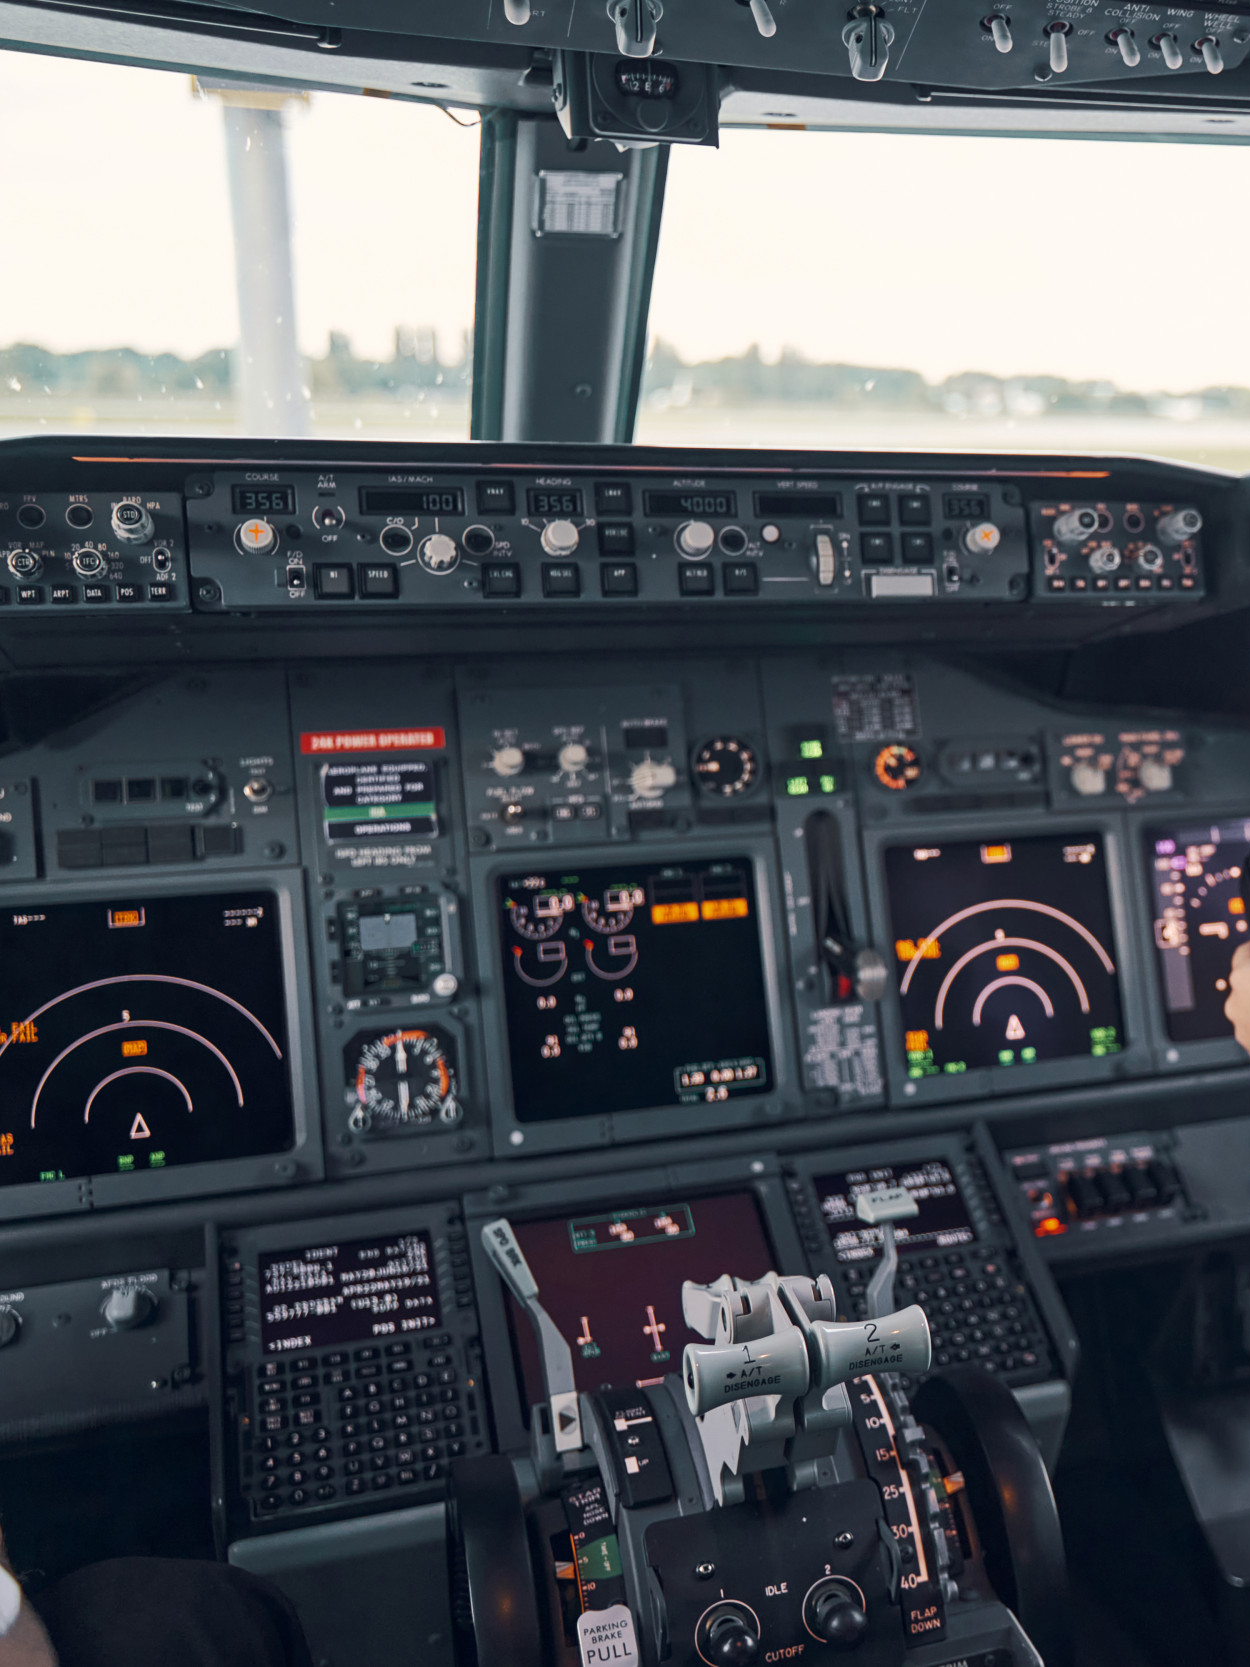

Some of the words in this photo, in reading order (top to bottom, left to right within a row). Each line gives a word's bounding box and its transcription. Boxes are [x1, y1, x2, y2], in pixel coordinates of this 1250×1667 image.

[1046, 2, 1082, 13] STROBE
[1123, 3, 1150, 12] ANTI
[1167, 8, 1194, 18] WING
[1048, 10, 1087, 19] STEADY
[1105, 8, 1161, 21] COLLISION
[1204, 12, 1240, 23] WHEEL
[1204, 20, 1233, 29] WELL
[245, 473, 279, 481] COURSE
[318, 474, 334, 482] A/T
[536, 478, 571, 486] HEADING
[317, 481, 336, 489] ARM
[69, 494, 88, 503] MTRS
[246, 493, 284, 509] 356
[423, 495, 453, 510] 100
[538, 496, 572, 512] 356
[146, 502, 161, 510] HPA
[681, 497, 726, 512] 4000
[122, 510, 137, 519] STD
[322, 535, 338, 543] OFF
[84, 541, 94, 549] 40
[98, 543, 107, 551] 80
[140, 556, 151, 564] OFF
[156, 573, 169, 581] ADF
[171, 573, 176, 581] 2
[20, 590, 36, 598] WPT
[53, 589, 70, 598] ARPT
[86, 589, 102, 597] DATA
[120, 588, 134, 596] POS
[151, 587, 166, 595] TERR
[336, 734, 377, 747] POWER
[378, 732, 434, 746] OPERATED
[354, 822, 411, 835] OPERATIONS
[372, 1321, 395, 1335] POS
[864, 1323, 880, 1342] 2
[743, 1345, 756, 1364] 1
[865, 1345, 886, 1356] A/T
[849, 1354, 903, 1370] DISENGAGE
[741, 1366, 763, 1379] A/T
[724, 1375, 781, 1393] DISENGAGE
[860, 1393, 871, 1404] 5
[865, 1416, 880, 1430] 10
[876, 1448, 890, 1461] 15
[883, 1484, 899, 1499] 25
[583, 1507, 604, 1518] NOSE
[583, 1512, 609, 1526] DOWN
[891, 1524, 908, 1540] 30
[824, 1564, 832, 1575] 2
[588, 1582, 596, 1591] 10
[901, 1573, 918, 1590] 40
[720, 1588, 724, 1599] 1
[765, 1582, 788, 1597] IDLE
[910, 1606, 938, 1621] FLAP
[583, 1620, 628, 1636] PARKING
[911, 1618, 941, 1634] DOWN
[592, 1631, 623, 1644] BRAKE
[587, 1642, 632, 1664] PULL
[765, 1644, 805, 1662] CUTOFF
